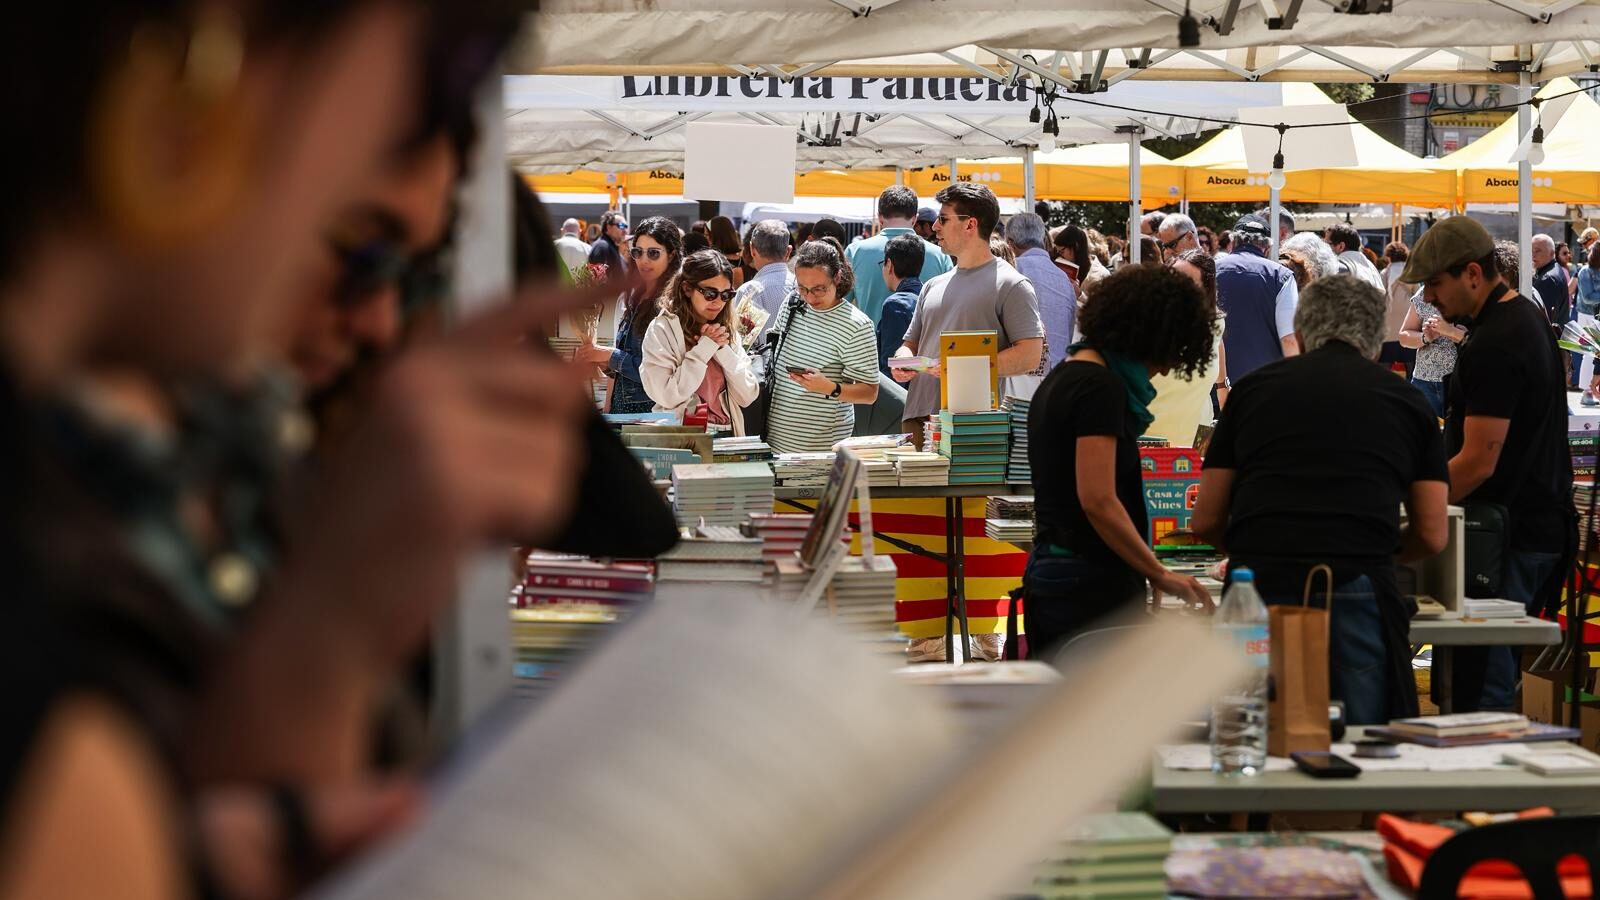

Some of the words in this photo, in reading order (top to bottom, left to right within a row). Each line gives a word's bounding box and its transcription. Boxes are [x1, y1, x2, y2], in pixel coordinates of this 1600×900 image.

[1207, 176, 1246, 185] Abacus
[1485, 178, 1519, 187] Abacu
[1146, 489, 1172, 498] Casa
[1149, 500, 1182, 509] Nines
